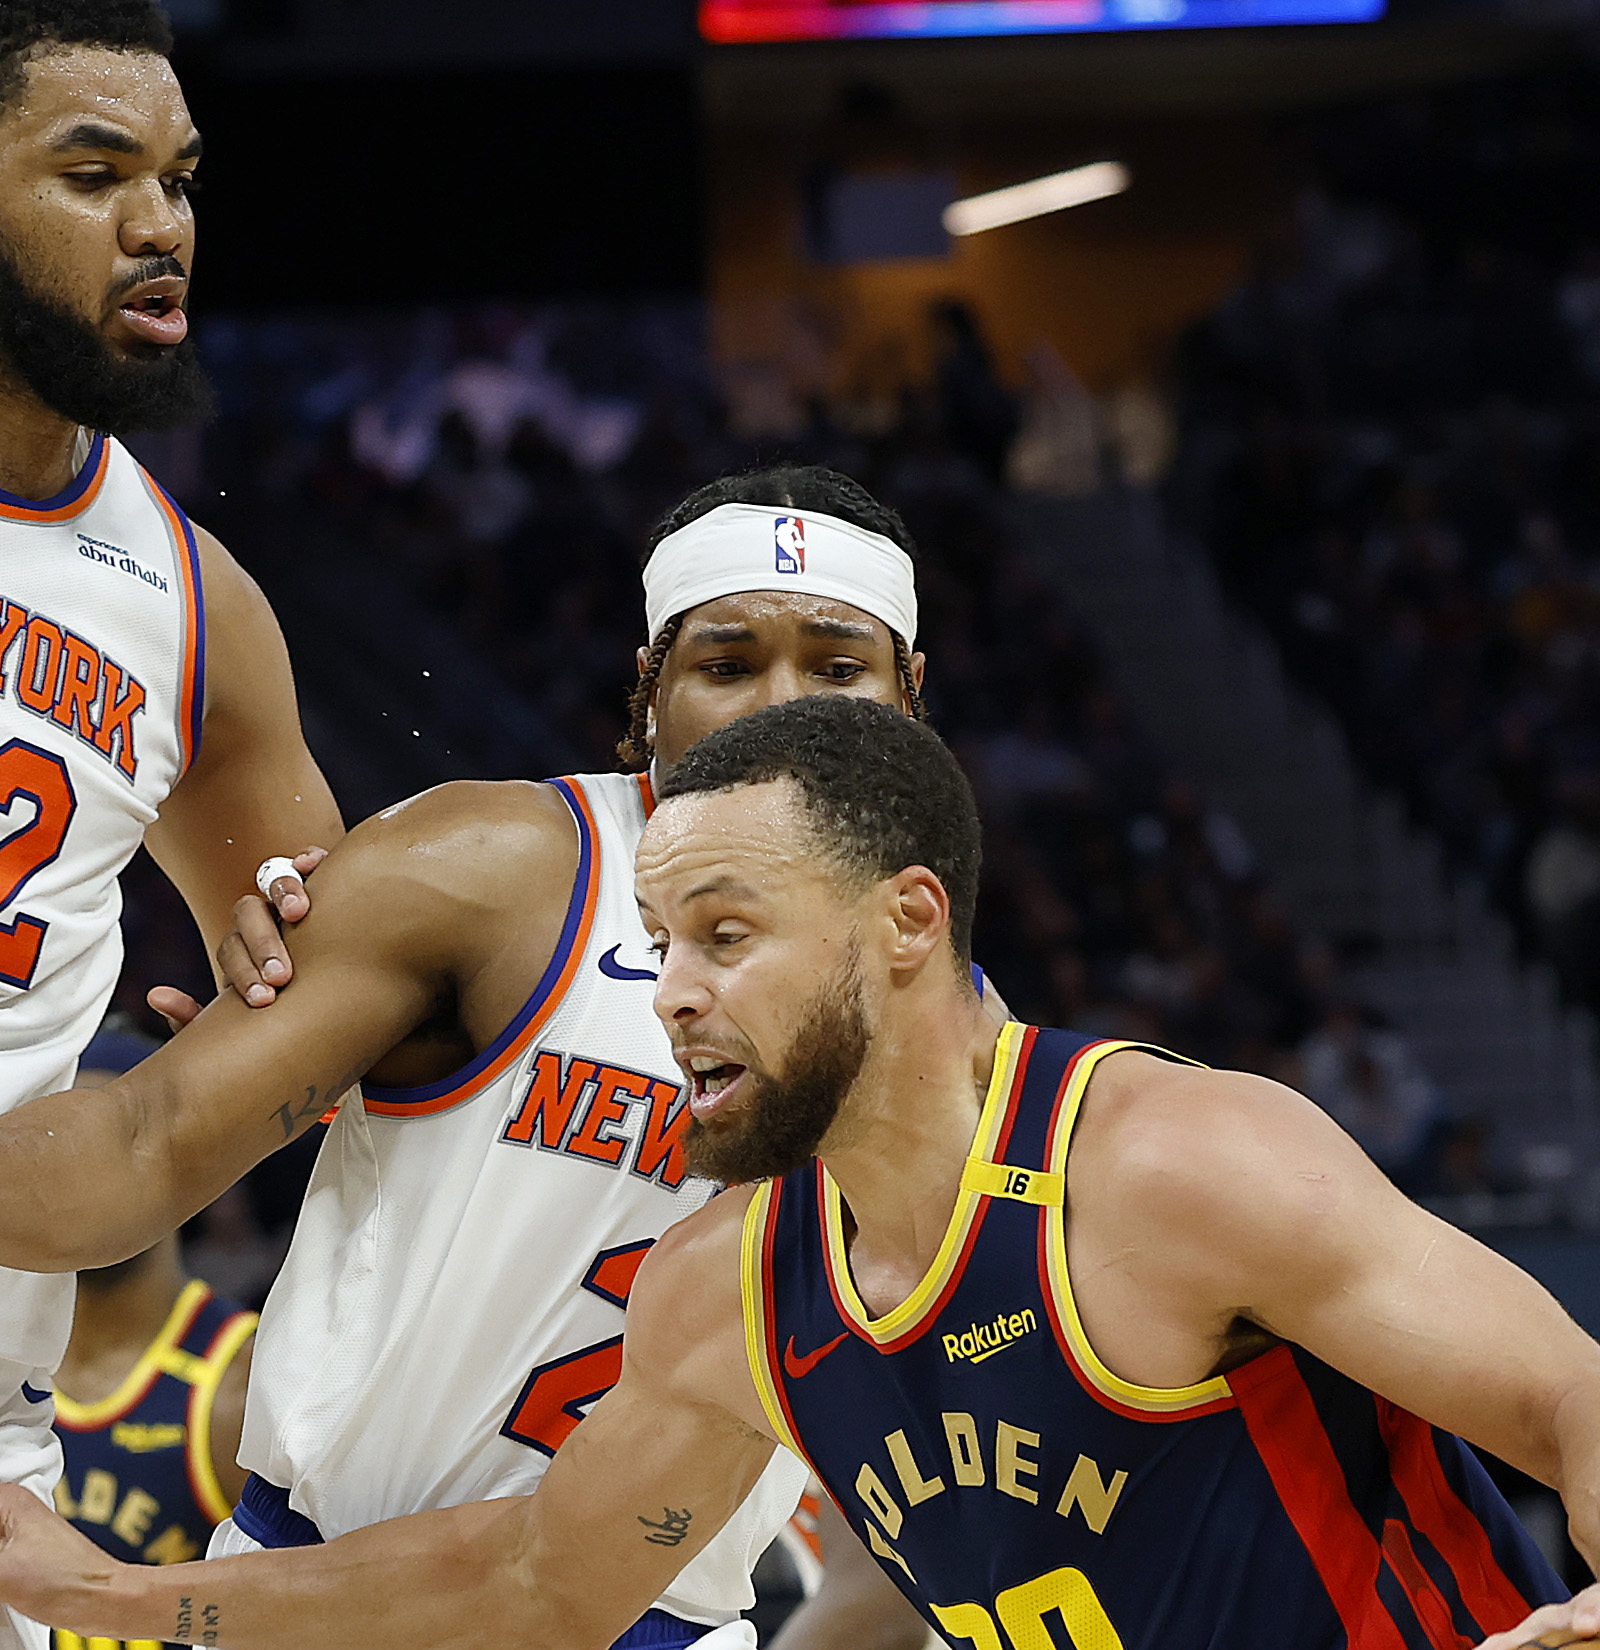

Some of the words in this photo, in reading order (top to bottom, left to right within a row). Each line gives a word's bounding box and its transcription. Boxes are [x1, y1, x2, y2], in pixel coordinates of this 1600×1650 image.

[76, 533, 129, 556] experience
[79, 544, 116, 567] abu
[120, 558, 168, 593] dhabi
[778, 559, 795, 572] NBA
[498, 1048, 692, 1193] NEW
[1004, 1170, 1031, 1196] 16
[941, 1308, 1038, 1363] Rakuten
